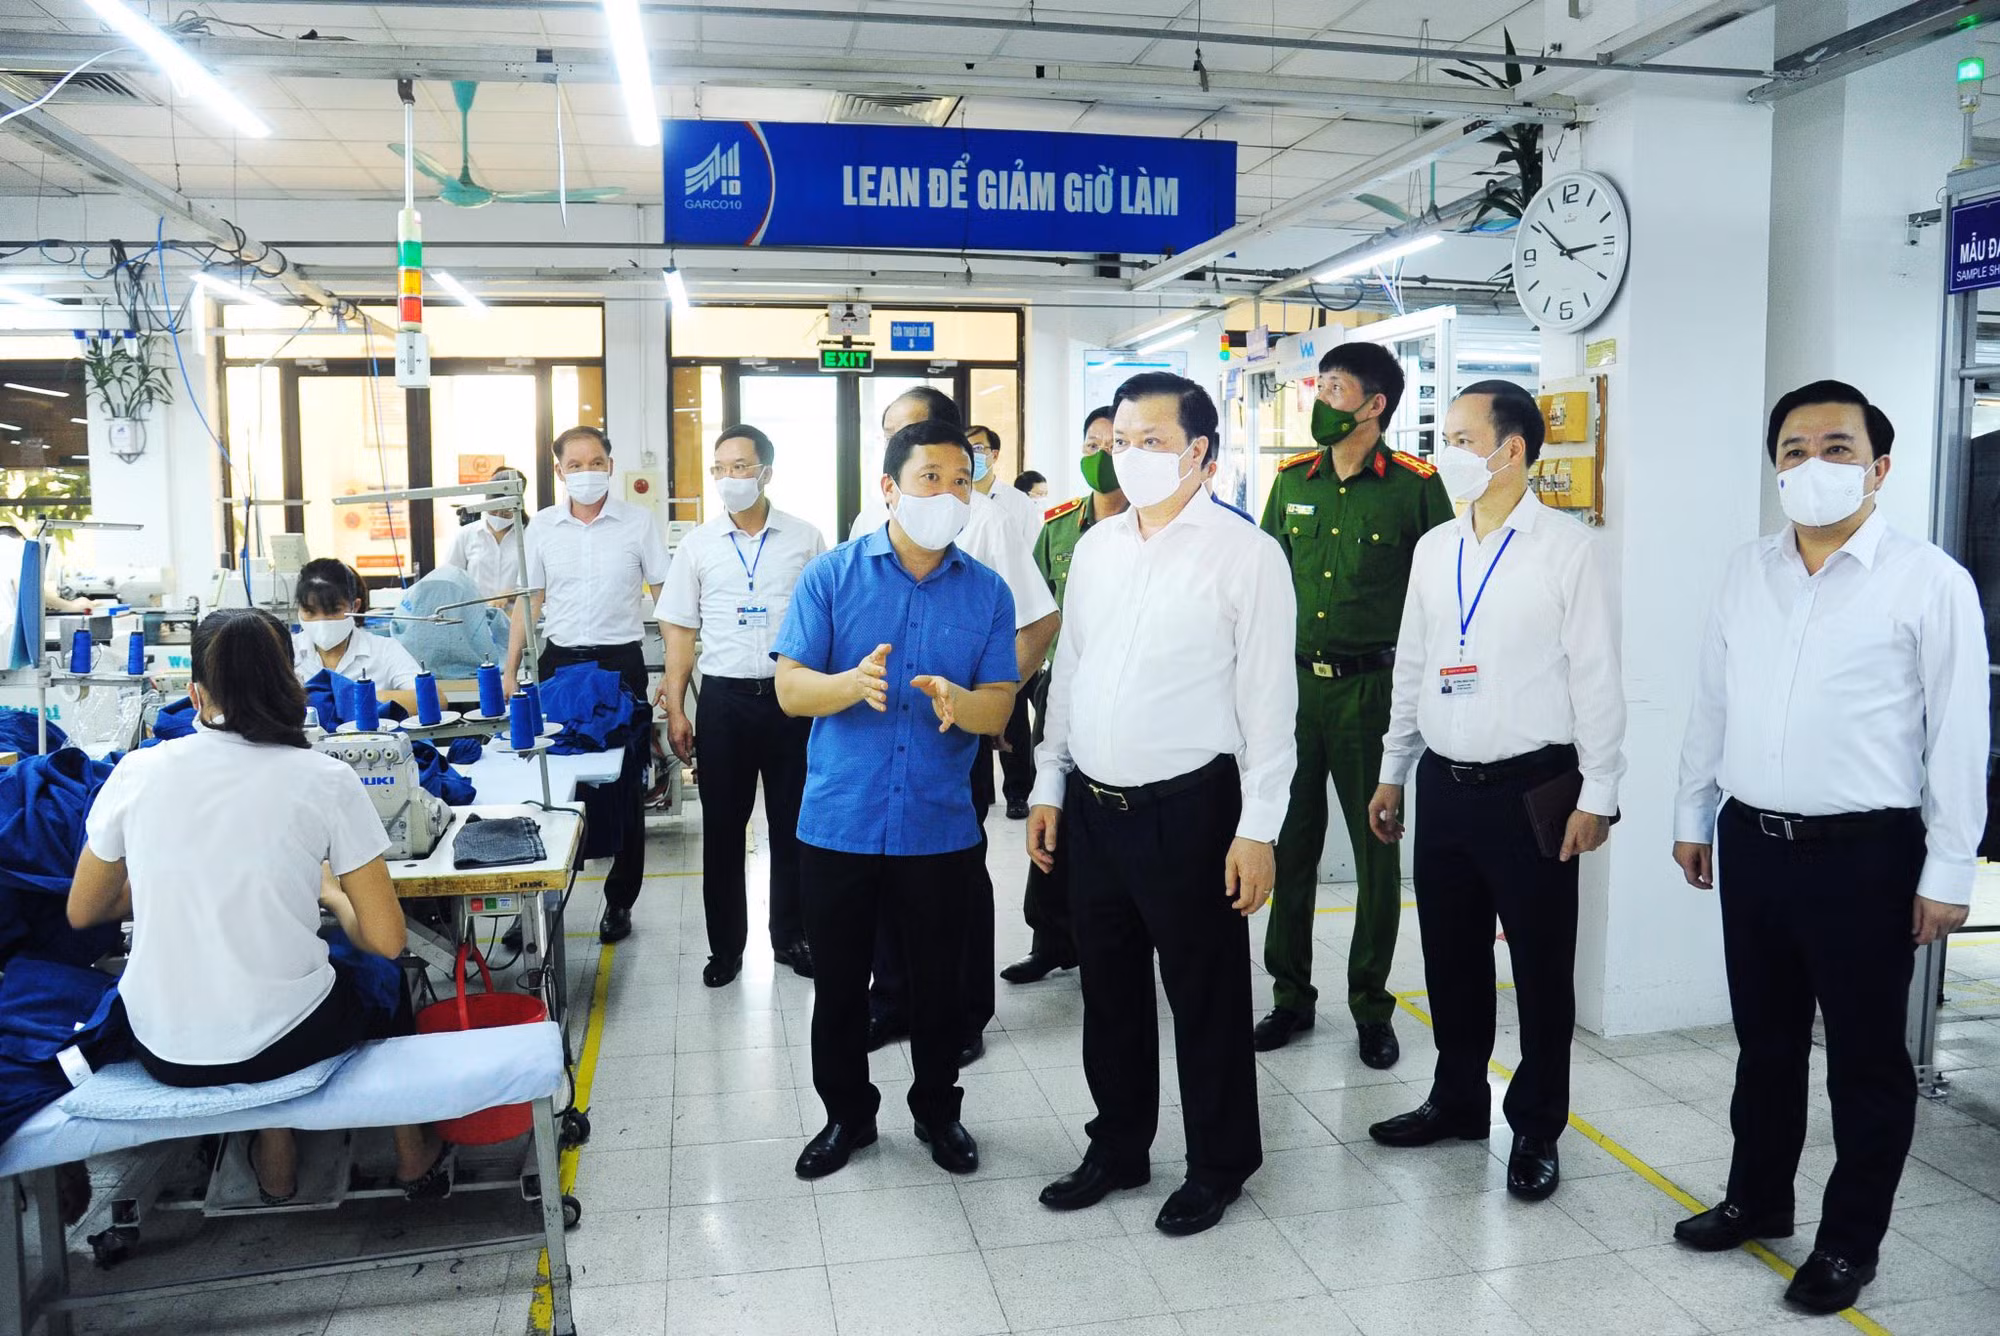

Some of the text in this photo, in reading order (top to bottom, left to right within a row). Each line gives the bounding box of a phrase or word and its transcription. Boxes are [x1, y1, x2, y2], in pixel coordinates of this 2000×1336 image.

[843, 165, 920, 207] LEAN
[928, 153, 971, 208] ĐỂ
[977, 159, 1056, 211] GIẢM
[1120, 167, 1179, 215] LÀM
[1562, 183, 1580, 204] 12
[684, 199, 742, 210] GARCO10
[1960, 232, 1987, 264] MẪU
[1523, 249, 1537, 268] 9
[1956, 265, 1987, 282] SAMPLE
[1559, 301, 1573, 320] 6
[824, 352, 868, 367] EXIT
